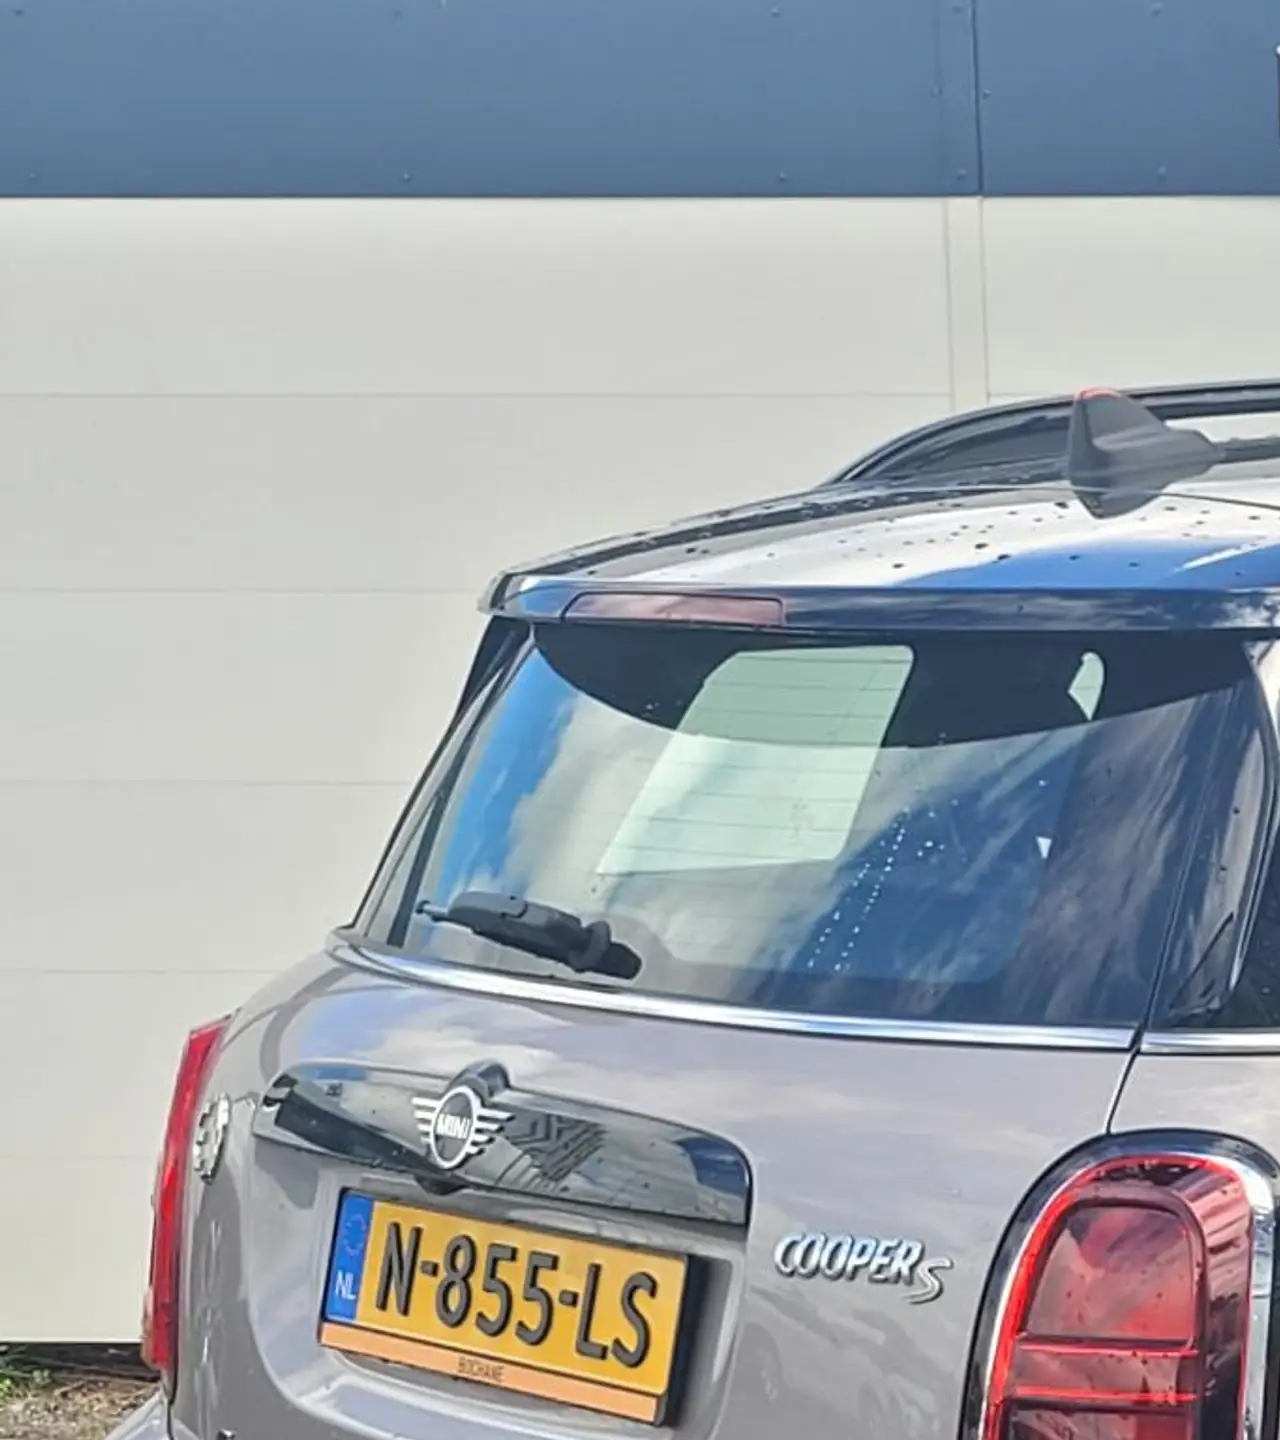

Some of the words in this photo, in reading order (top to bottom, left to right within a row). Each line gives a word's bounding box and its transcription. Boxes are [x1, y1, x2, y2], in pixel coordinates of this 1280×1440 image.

[334, 1272, 356, 1300] NL
[375, 1221, 658, 1368] N-855-LS
[774, 1232, 924, 1287] COOPER
[900, 1256, 954, 1305] S
